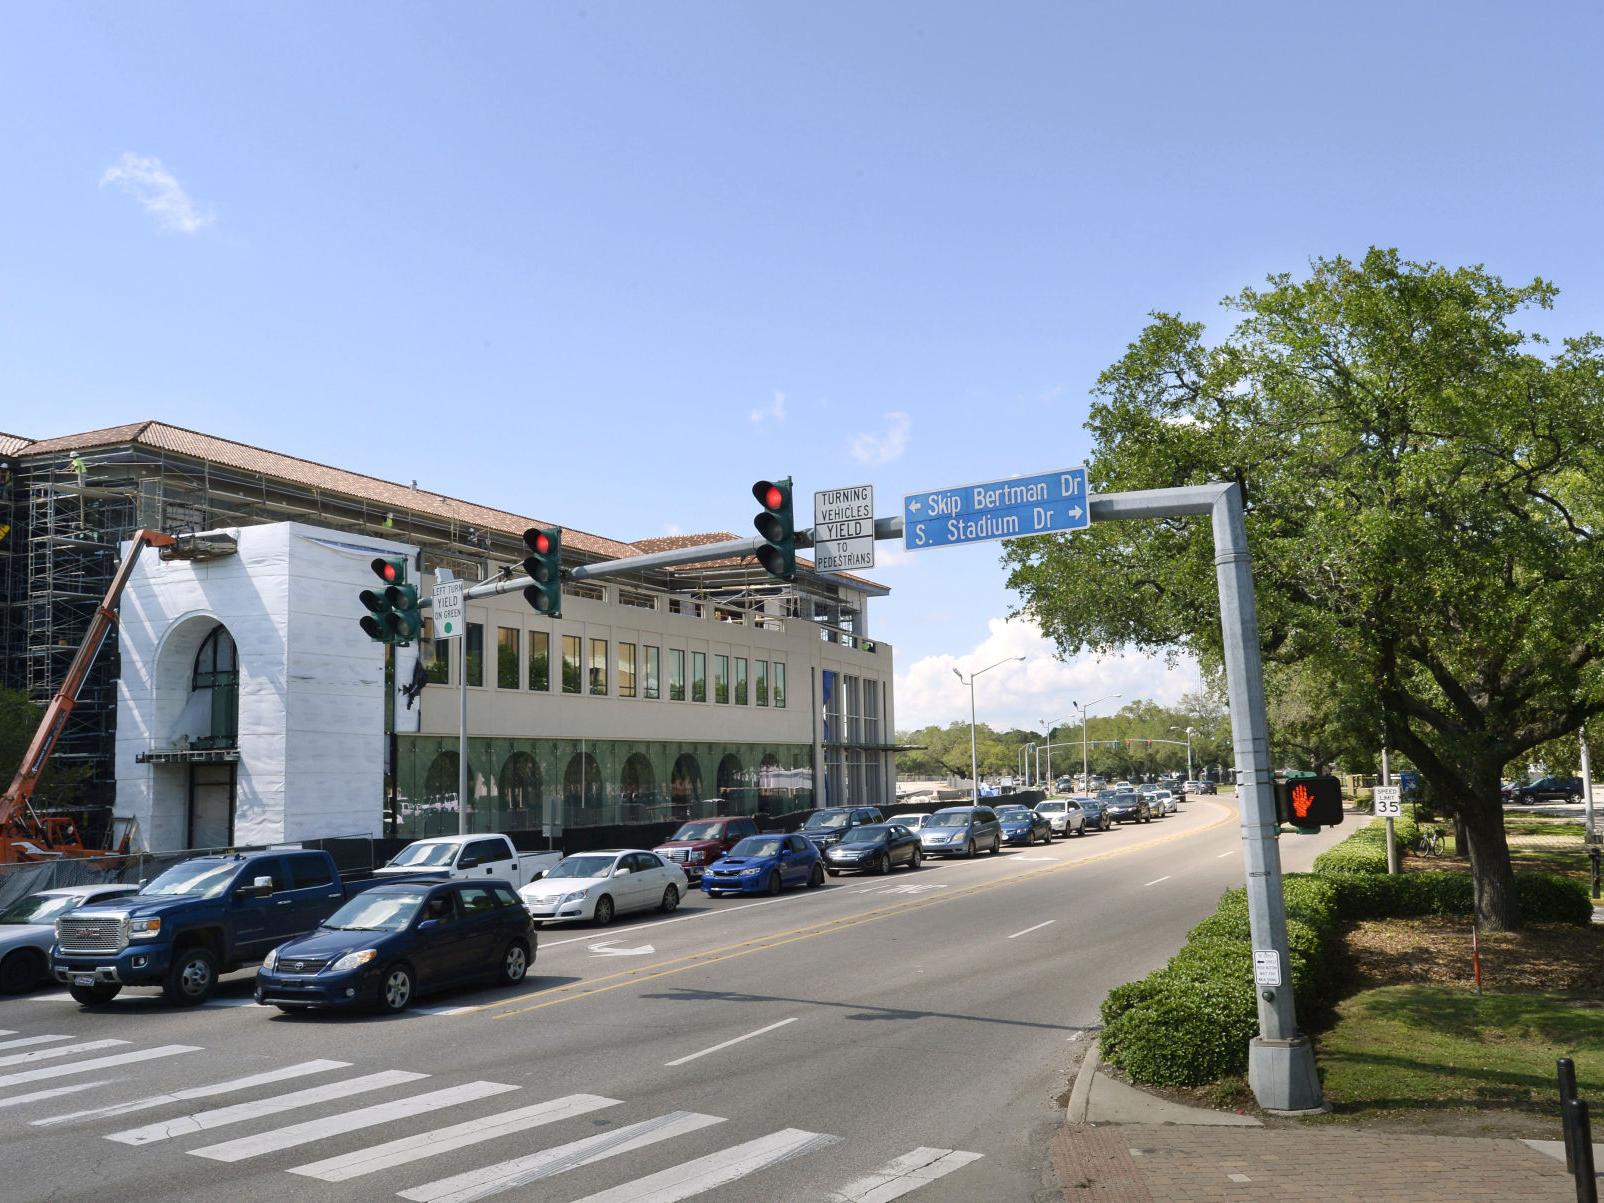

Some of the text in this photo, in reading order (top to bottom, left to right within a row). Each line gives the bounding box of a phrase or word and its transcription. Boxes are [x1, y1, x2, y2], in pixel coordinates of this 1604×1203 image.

[821, 487, 868, 506] TURNING
[927, 474, 1082, 519] Skip Bertman Dr
[821, 504, 869, 521] VEHICLES
[827, 522, 862, 539] YIELD
[915, 507, 1055, 545] S. Stadium Dr
[837, 542, 848, 553] TO
[817, 552, 871, 569] PEDESTRIANS
[433, 584, 463, 597] LEFT TURN
[437, 596, 458, 608] YIELD
[435, 609, 461, 620] ON GREEN
[1378, 801, 1399, 813] 35
